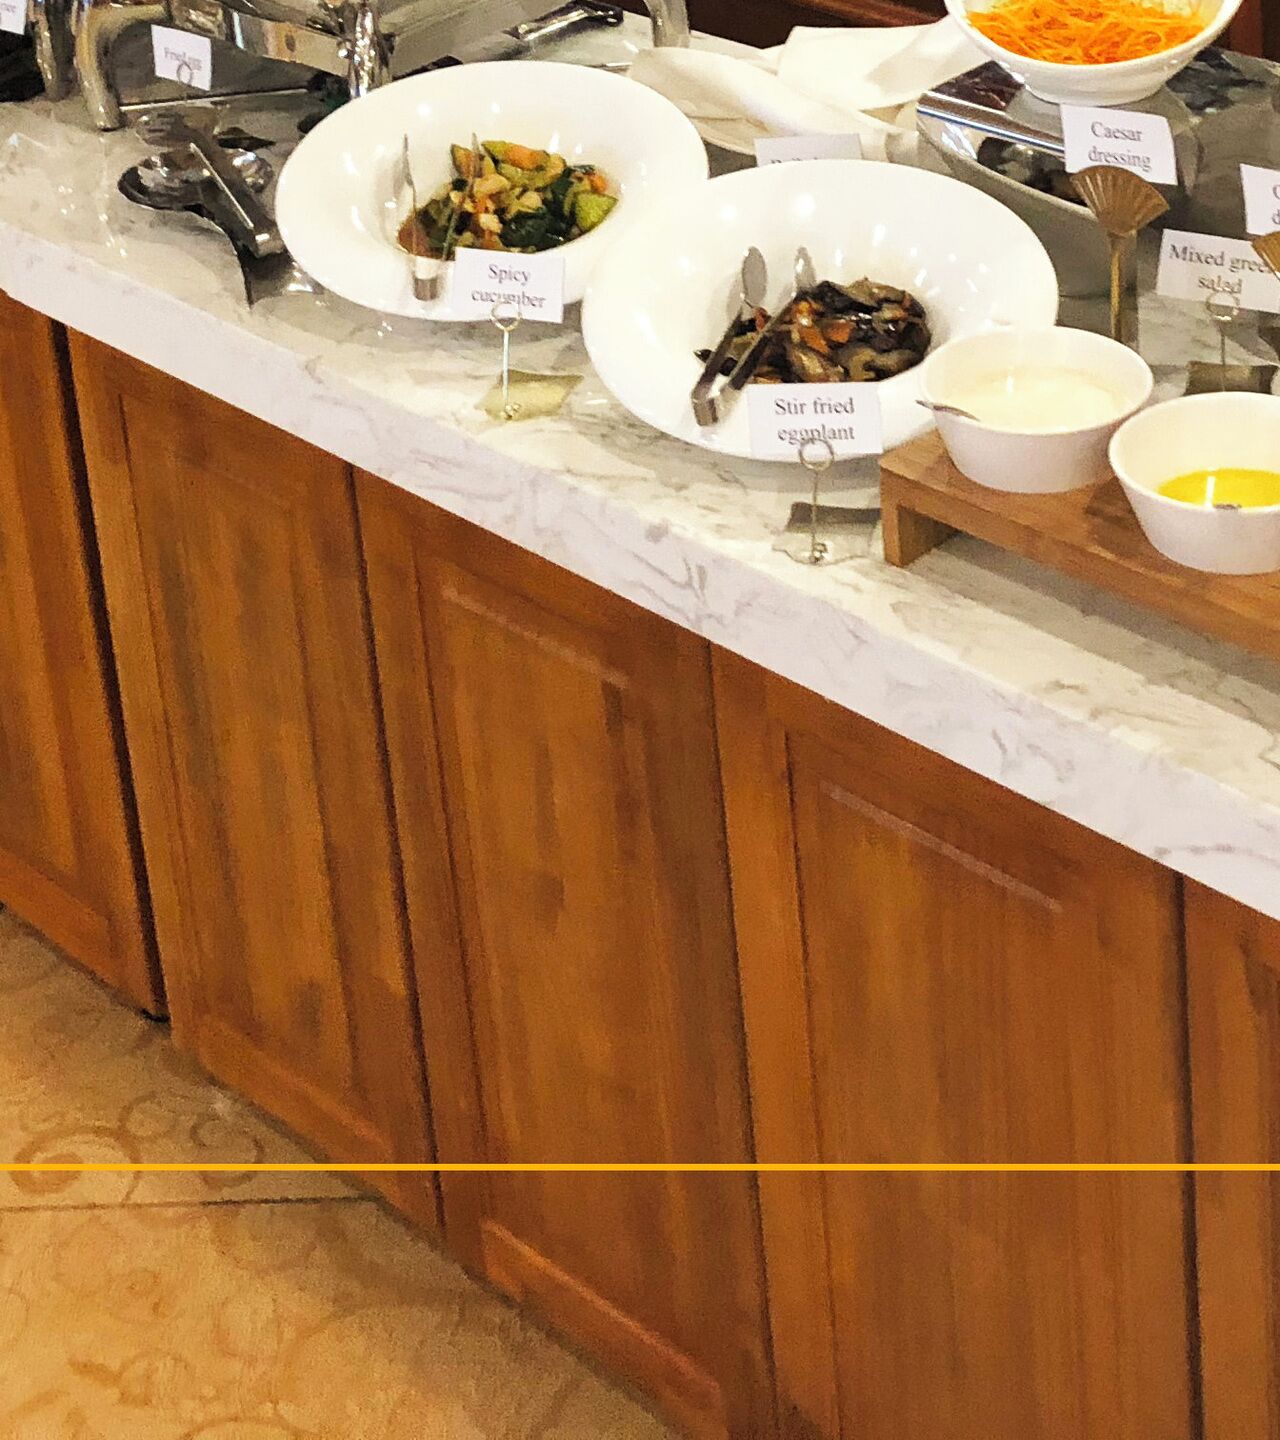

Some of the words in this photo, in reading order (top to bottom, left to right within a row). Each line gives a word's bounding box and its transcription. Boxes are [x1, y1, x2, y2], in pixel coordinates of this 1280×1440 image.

[1090, 121, 1143, 142] Caesar
[1088, 145, 1152, 173] dressing
[1170, 244, 1225, 266] Mixed
[1228, 258, 1273, 273] gree
[488, 263, 530, 286] Spicy
[471, 290, 546, 308] cucumber
[775, 398, 806, 415] Stir
[813, 397, 854, 414] fried
[778, 424, 855, 445] eggplant
